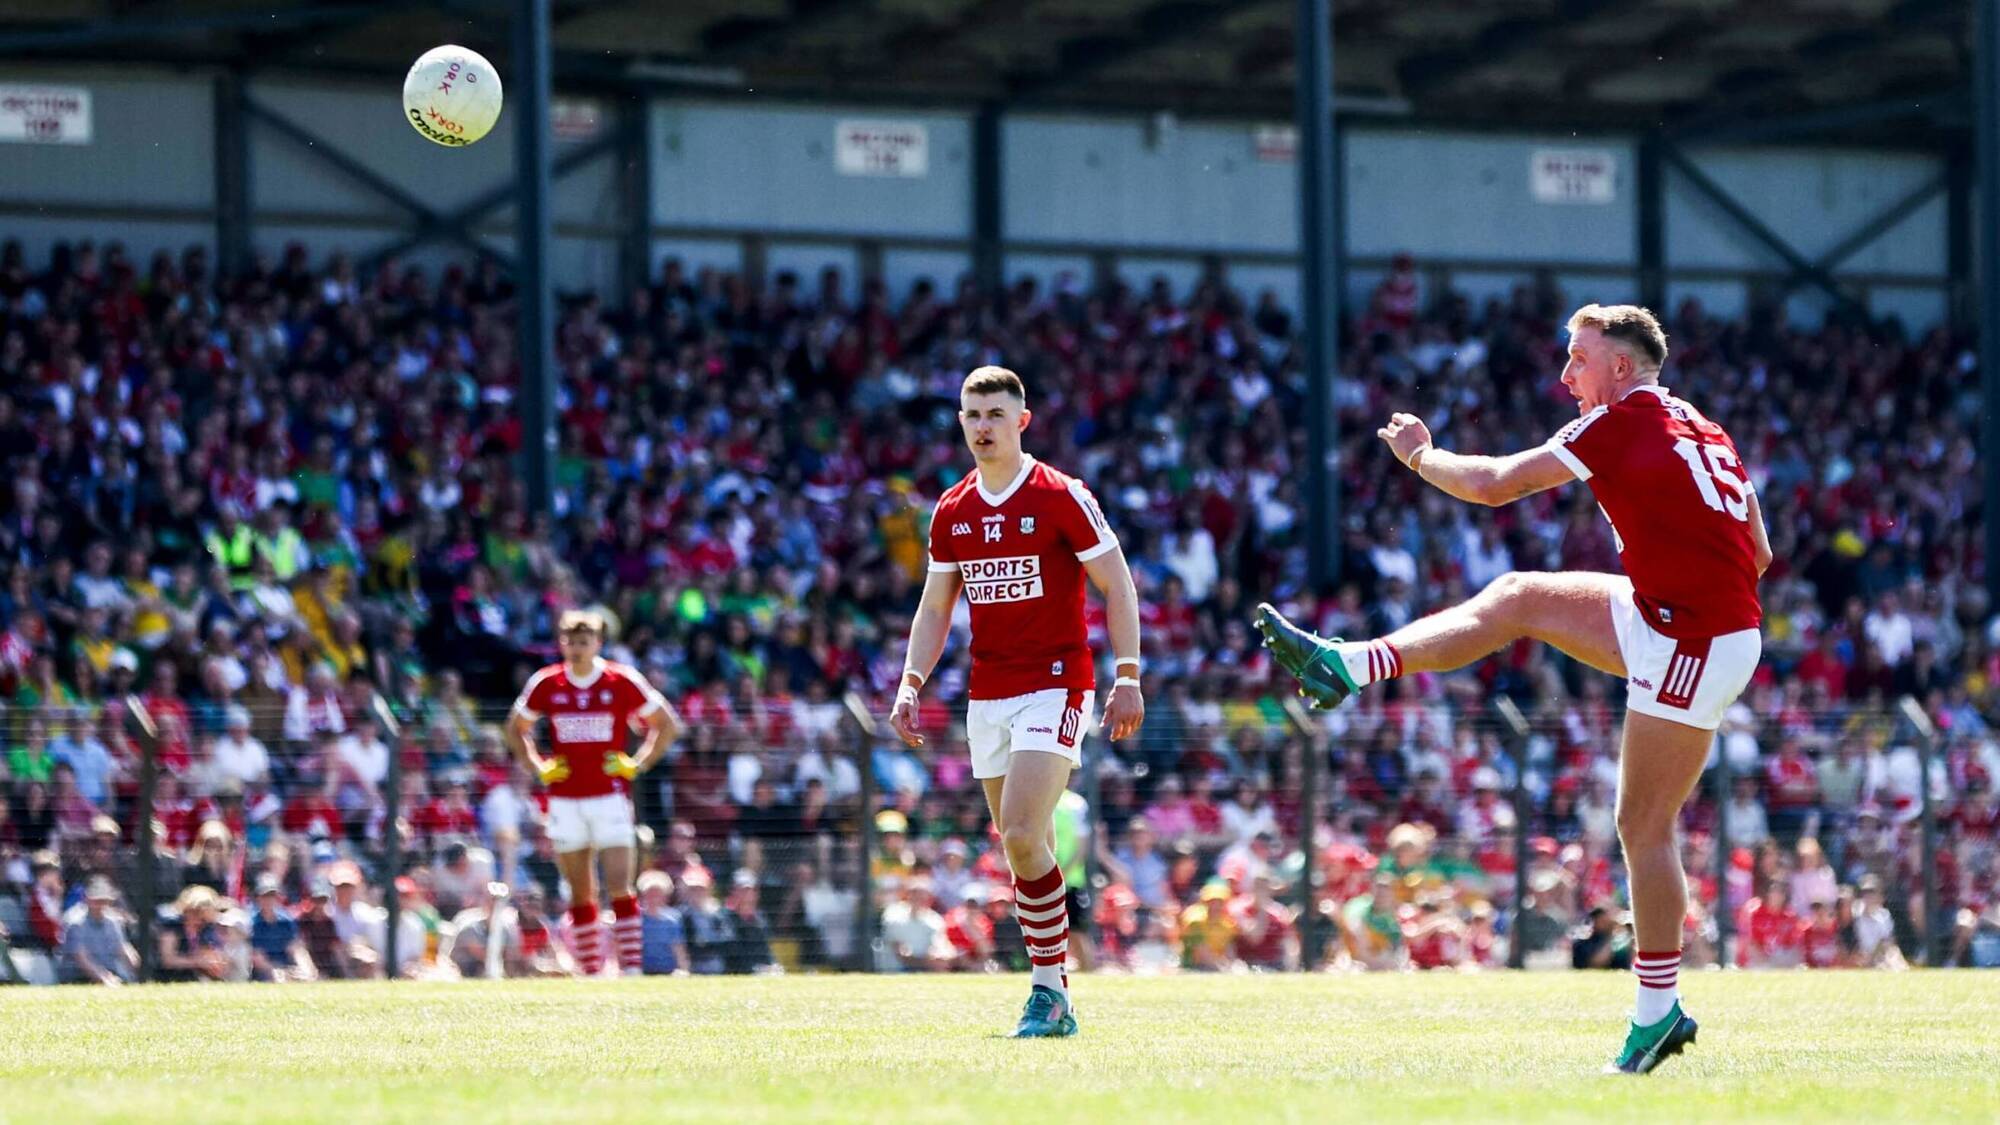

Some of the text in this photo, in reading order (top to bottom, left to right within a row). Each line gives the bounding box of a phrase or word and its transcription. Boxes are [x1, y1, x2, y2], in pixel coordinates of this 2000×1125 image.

[427, 106, 464, 134] CORK
[1673, 437, 1749, 522] 15
[983, 523, 1002, 543] 14
[963, 559, 1034, 579] SPORTS
[969, 581, 1035, 601] DIRECT
